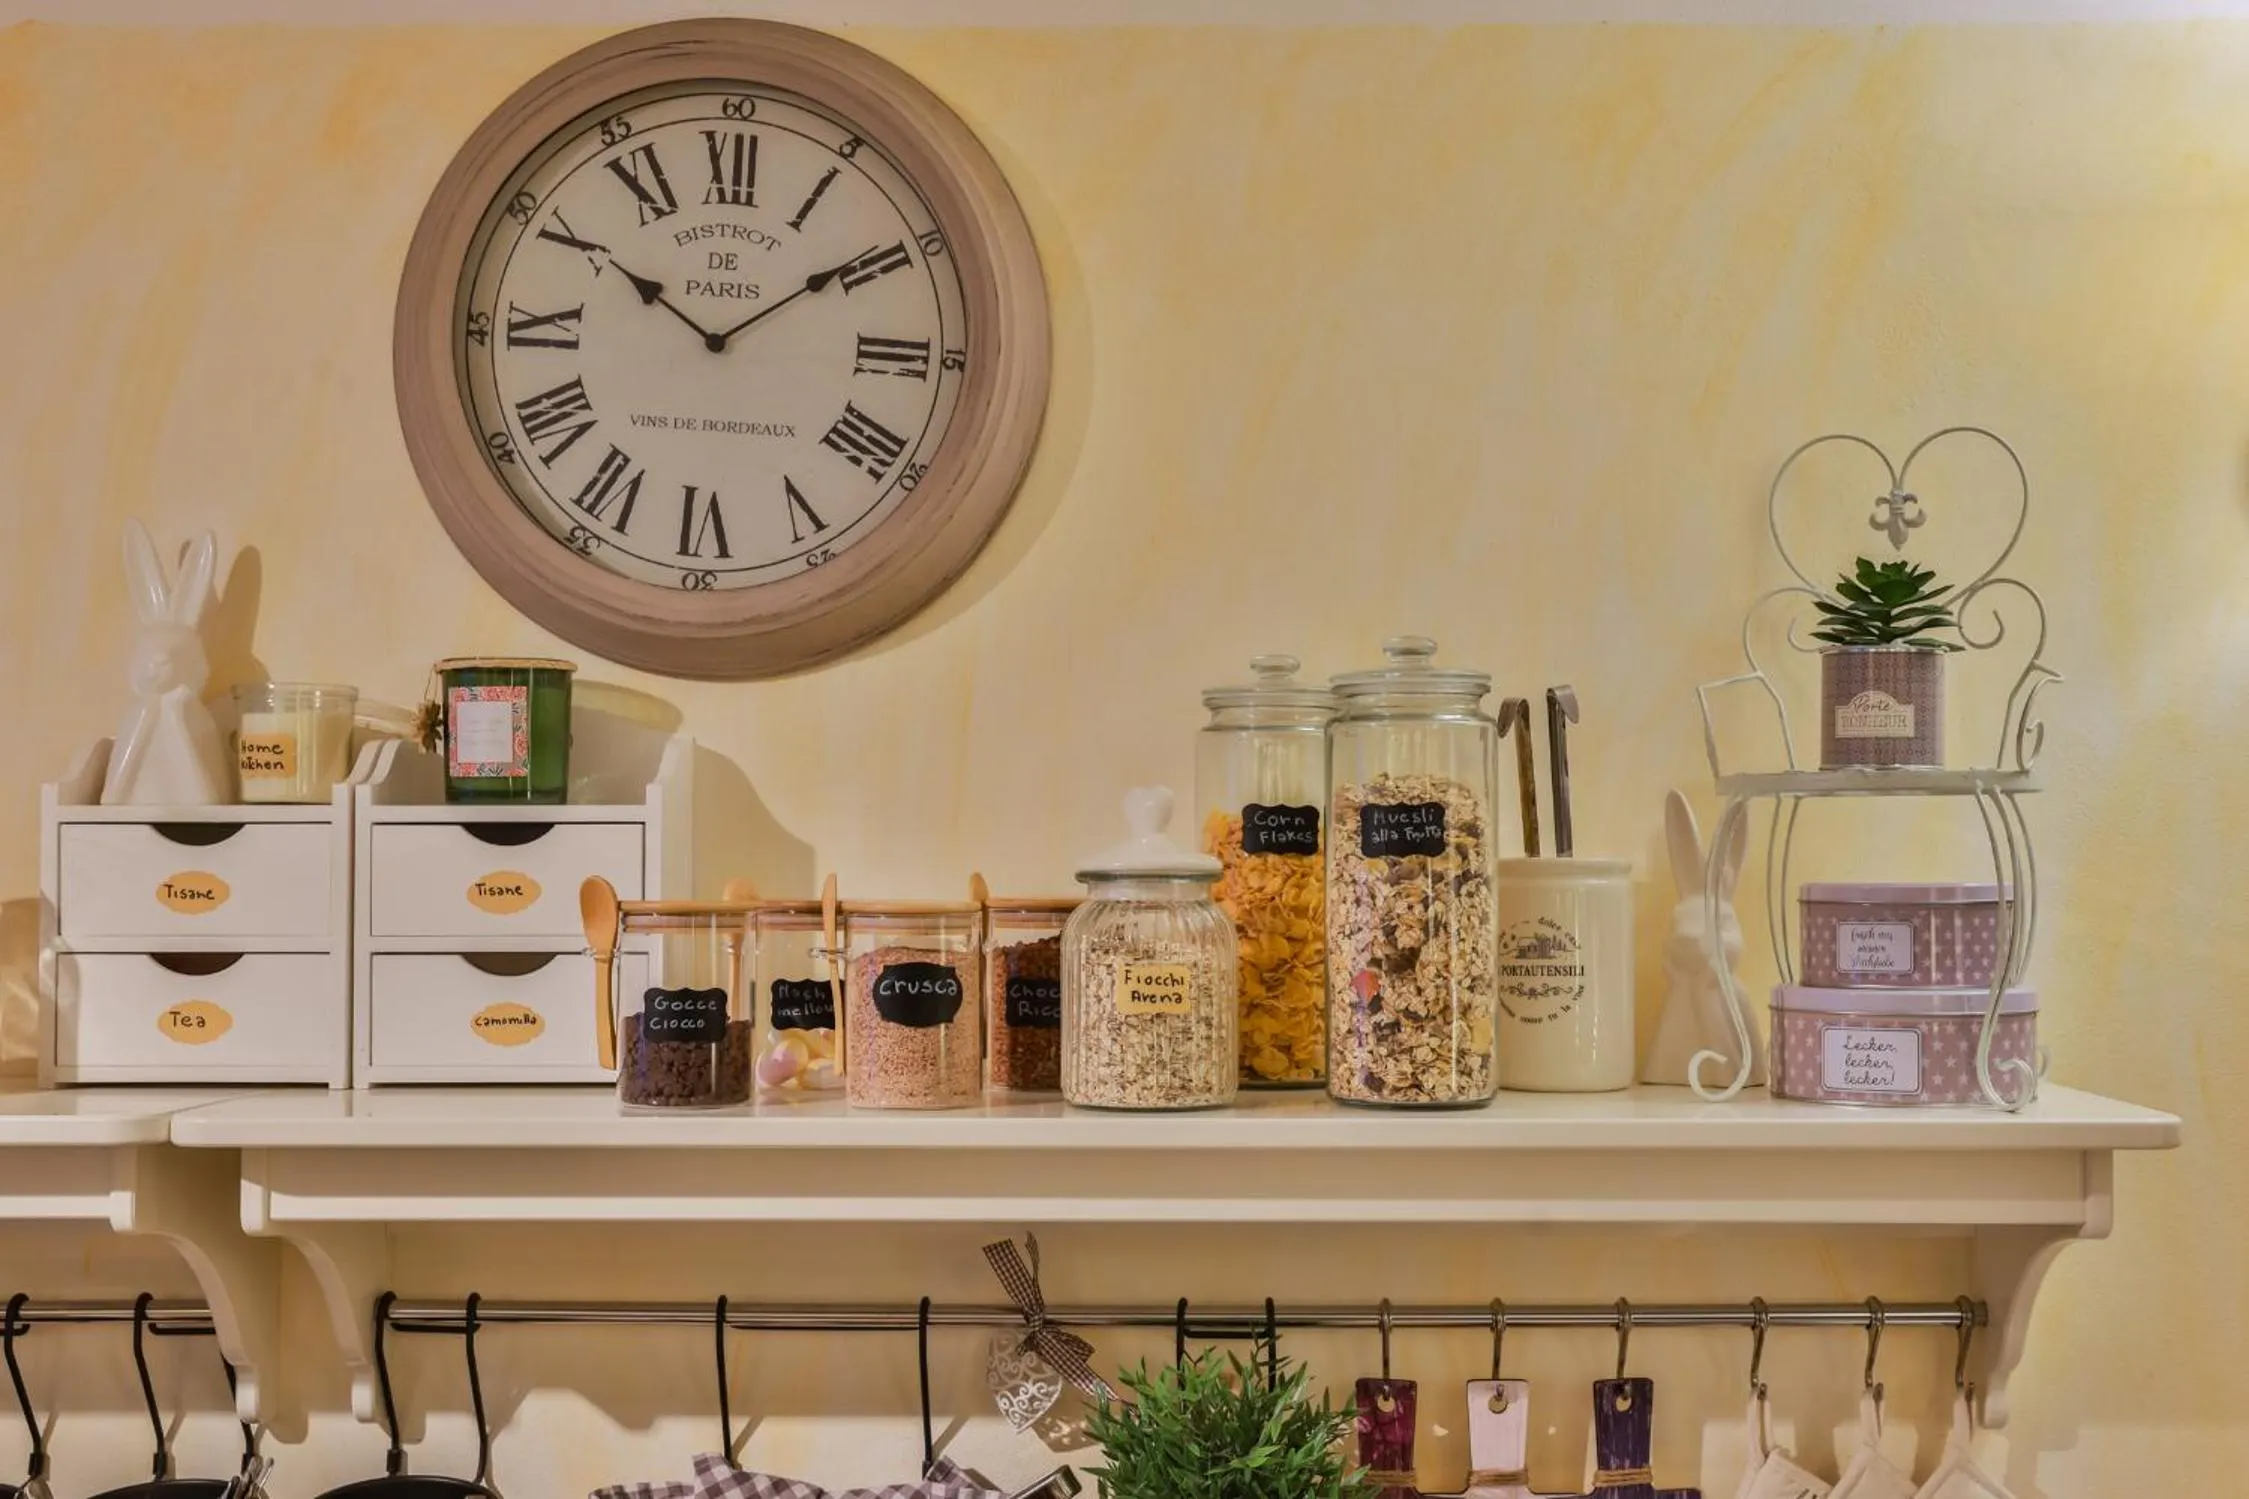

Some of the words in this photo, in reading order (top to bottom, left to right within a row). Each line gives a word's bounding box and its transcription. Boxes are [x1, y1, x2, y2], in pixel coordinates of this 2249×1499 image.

[722, 97, 756, 120] 60
[601, 116, 632, 147] 55
[698, 130, 759, 208] XII
[603, 142, 679, 228] XI
[506, 191, 538, 226] 50
[535, 205, 612, 278] X
[673, 223, 782, 252] BISTROT
[918, 230, 944, 257] 10
[707, 252, 739, 271] DE
[838, 239, 914, 297] II
[684, 280, 760, 300] PARIS
[467, 311, 490, 347] 45
[507, 300, 586, 352] IX
[853, 331, 930, 383] III
[942, 348, 967, 373] 15
[515, 374, 599, 470] VIII
[630, 413, 669, 428] VINS
[673, 416, 697, 431] DE
[701, 418, 797, 438] BORDEAUX
[488, 431, 516, 466] 40
[569, 442, 646, 537] VII
[899, 462, 929, 492] 20
[675, 485, 734, 559] VI
[783, 474, 830, 544] V
[681, 571, 718, 592] 30
[1254, 810, 1305, 826] Corn
[1374, 808, 1434, 825] Muesli
[1260, 831, 1312, 844] Flakes
[164, 883, 215, 900] Tisane
[475, 883, 523, 896] Tisane
[1124, 969, 1184, 987] Fiocchi
[1131, 990, 1182, 1004] Avena
[169, 1011, 206, 1028] Tea
